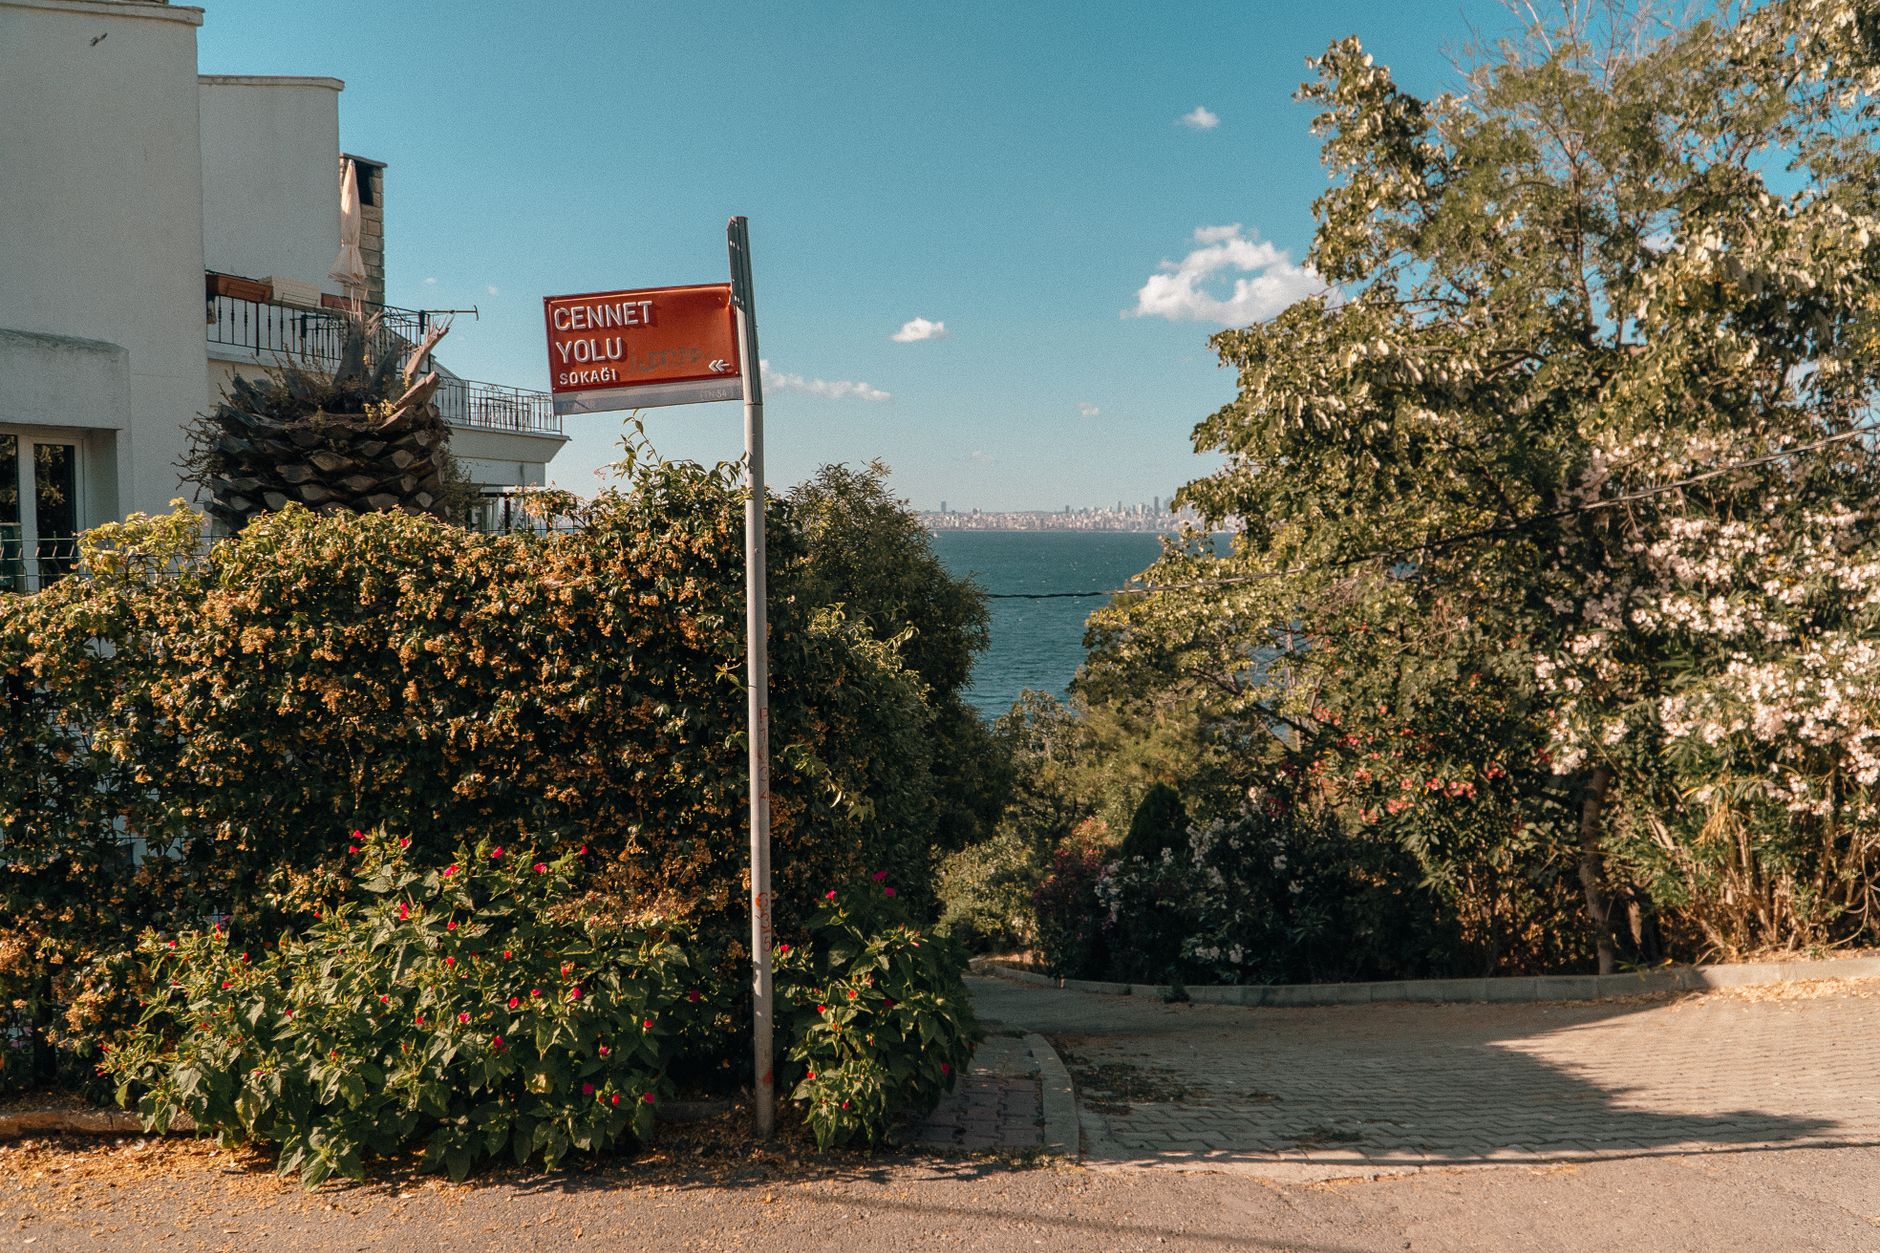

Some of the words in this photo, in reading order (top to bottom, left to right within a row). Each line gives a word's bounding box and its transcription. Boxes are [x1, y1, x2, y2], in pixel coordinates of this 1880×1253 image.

[554, 300, 653, 332] CENNET
[555, 336, 624, 364] YOLU
[559, 367, 618, 385] SOKAĞI
